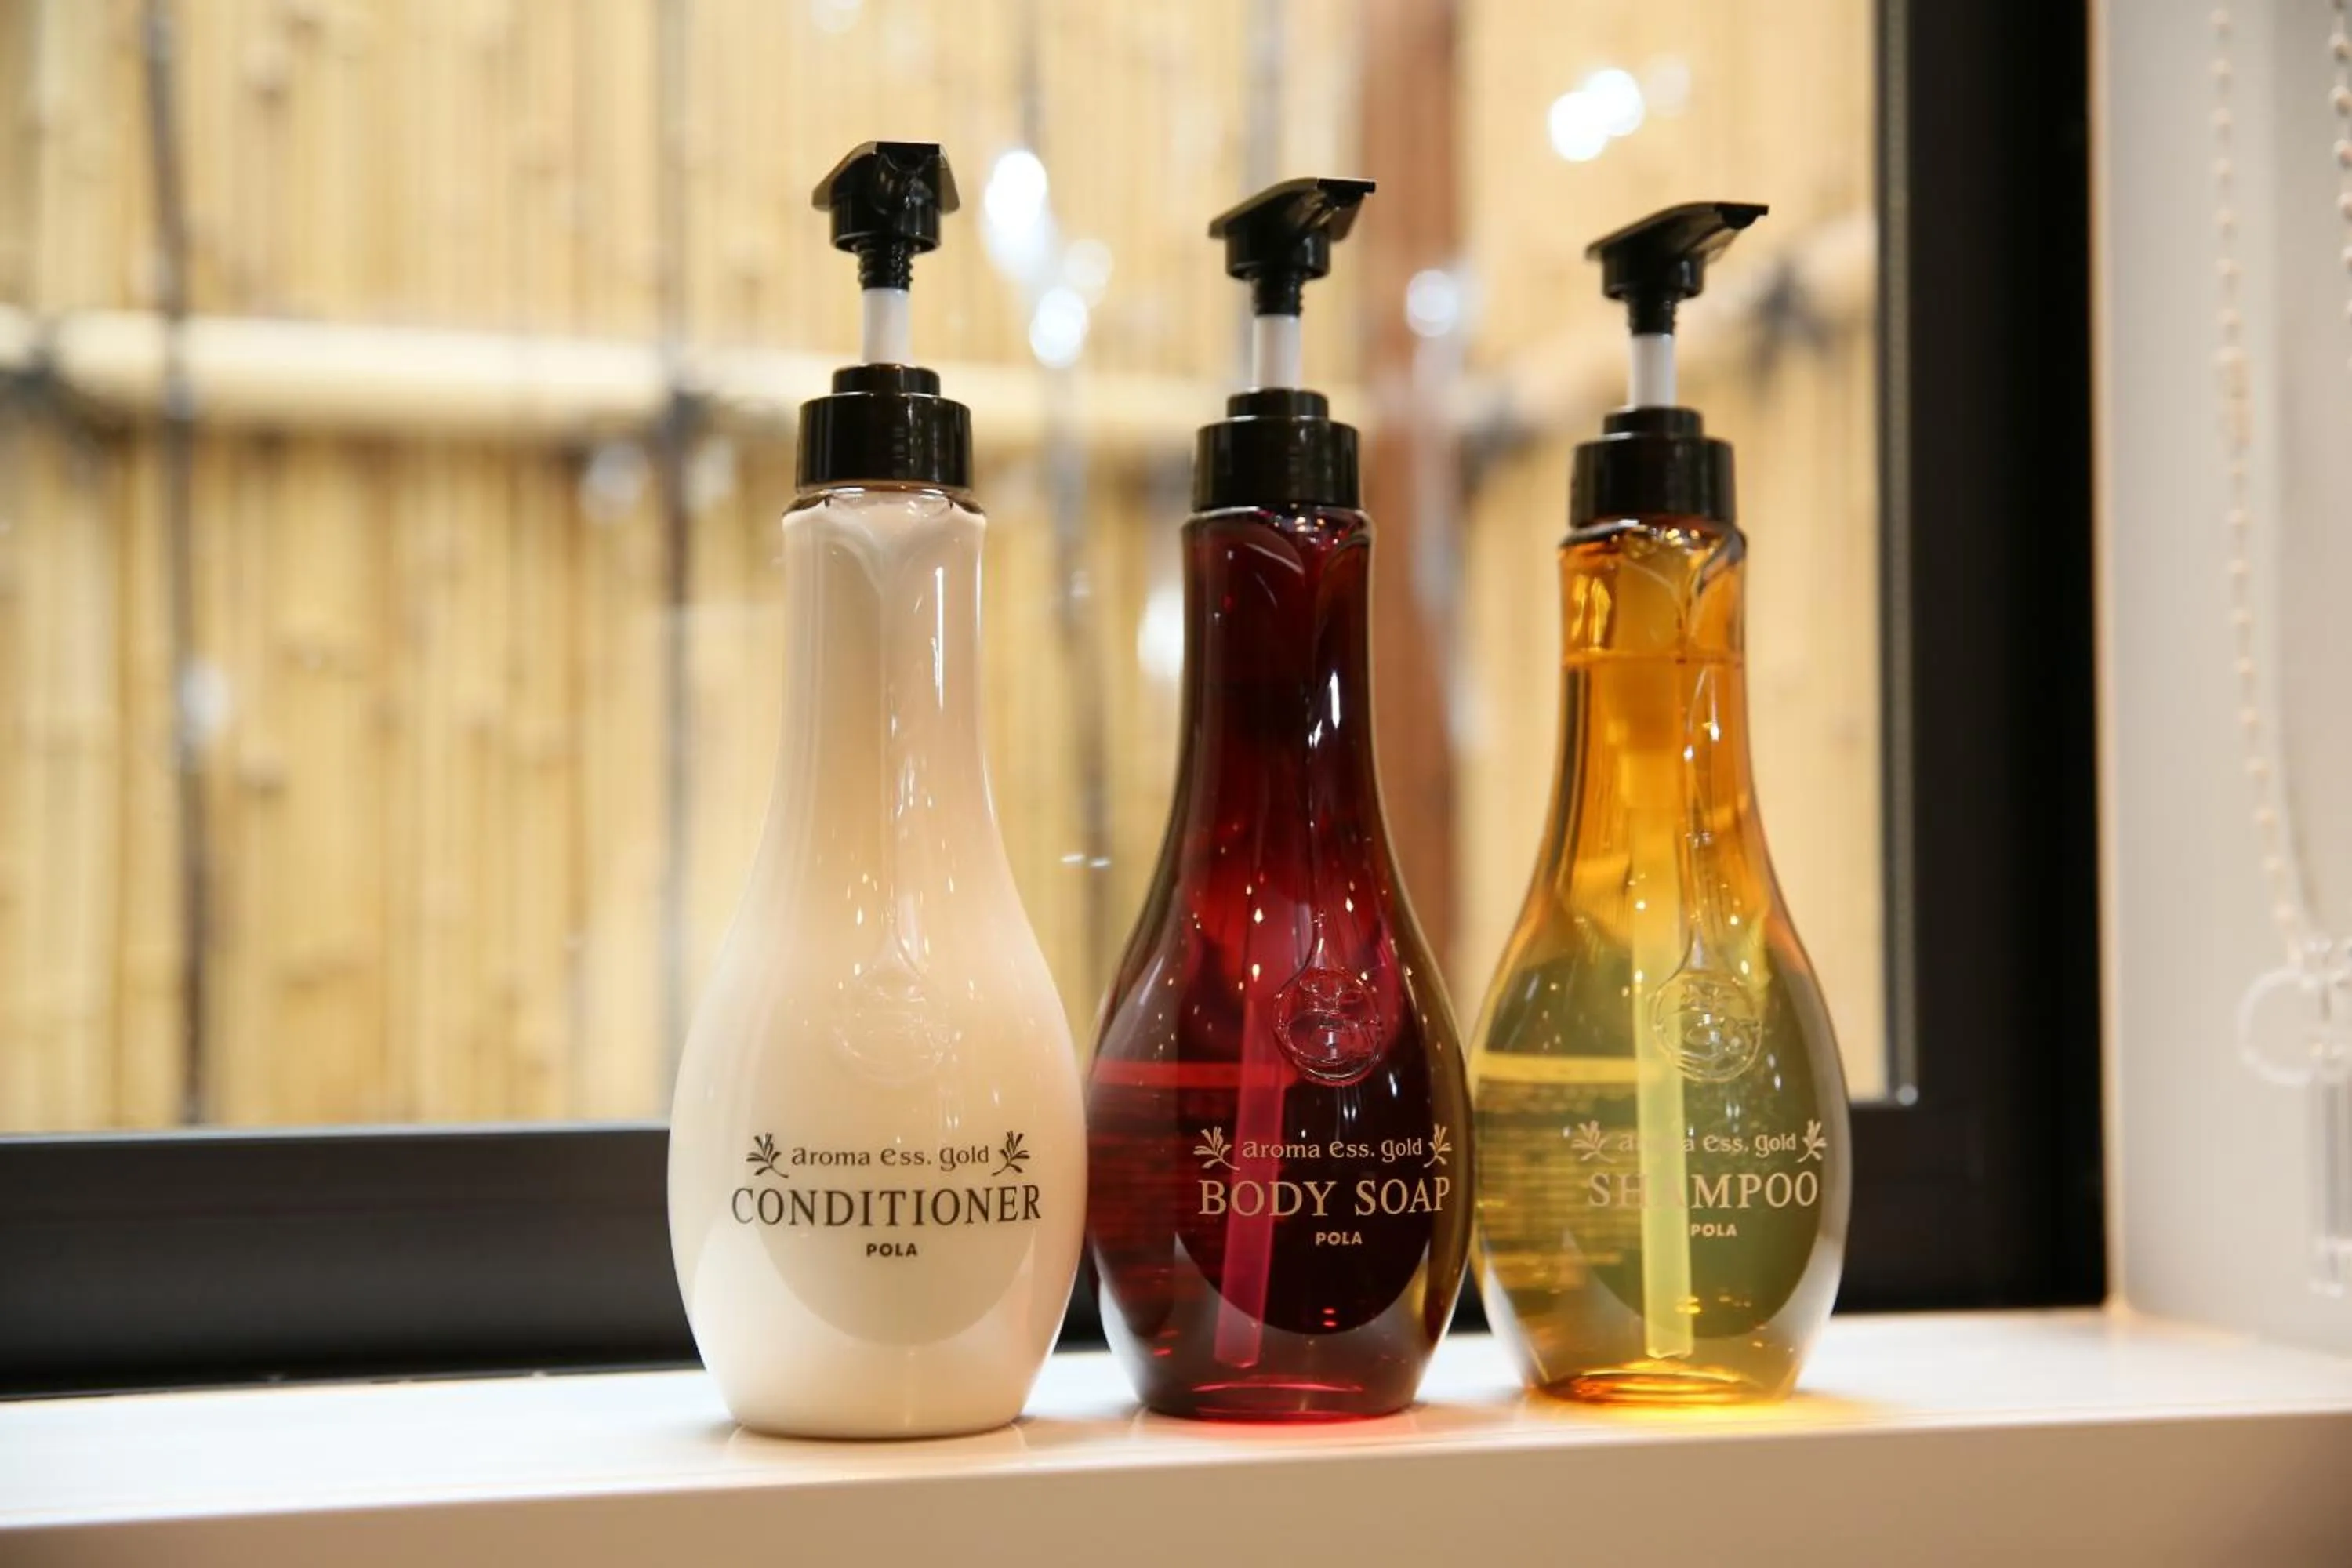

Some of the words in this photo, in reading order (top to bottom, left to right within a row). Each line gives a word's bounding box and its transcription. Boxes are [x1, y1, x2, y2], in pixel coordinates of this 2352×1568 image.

[791, 1147, 871, 1166] aroma
[880, 1145, 931, 1166] ess.
[940, 1145, 989, 1171] gold
[1241, 1140, 1321, 1159] aroma
[1329, 1140, 1374, 1158] ess.
[1381, 1138, 1422, 1162] gold
[1703, 1133, 1749, 1152] ess.
[1755, 1133, 1796, 1158] gold
[1197, 1179, 1337, 1217] BODY
[1355, 1176, 1450, 1217] SOAP
[1588, 1171, 1817, 1209] SHMPOO
[731, 1185, 1041, 1226] CONDITIONER
[1315, 1231, 1363, 1246] POLA
[1690, 1223, 1737, 1237] POLA
[866, 1243, 918, 1257] POLA
